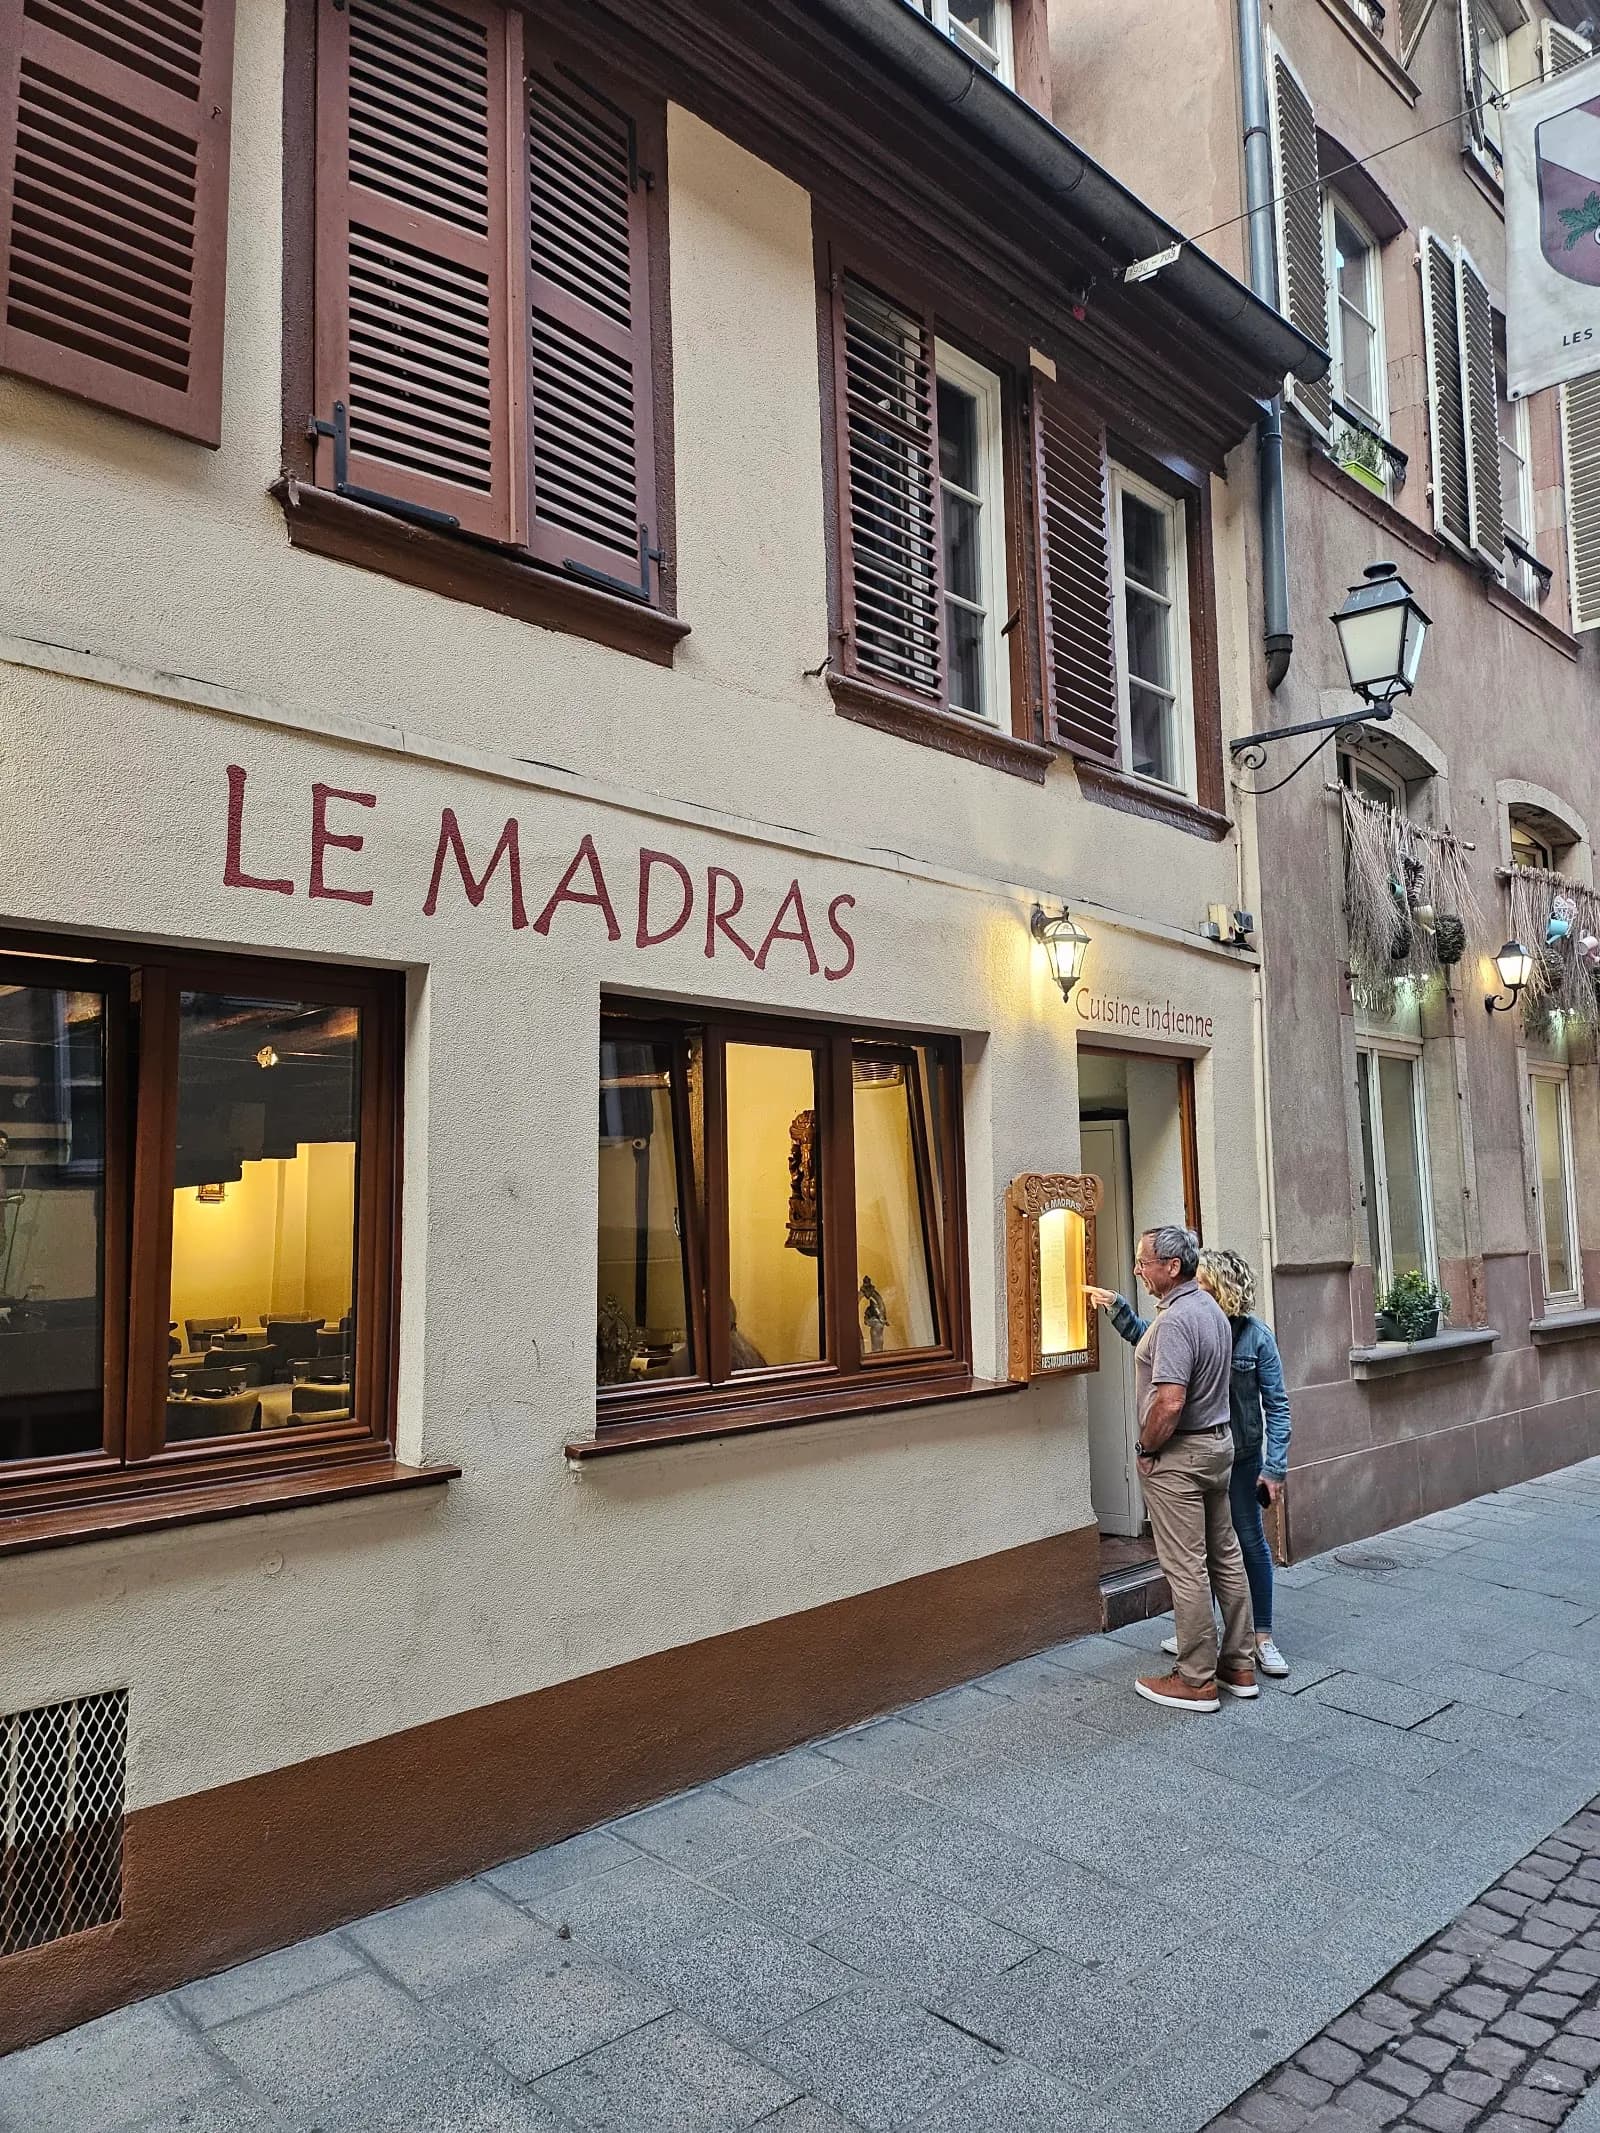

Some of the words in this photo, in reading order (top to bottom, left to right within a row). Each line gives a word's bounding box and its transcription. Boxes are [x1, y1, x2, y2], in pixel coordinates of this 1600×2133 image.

[1562, 328, 1593, 347] LES
[223, 764, 376, 905] LE
[422, 808, 856, 981] MADRAS
[1076, 988, 1140, 1026] Cuisine
[1146, 1000, 1213, 1037] indienne
[1040, 1201, 1051, 1214] LE
[1050, 1198, 1082, 1211] MADRAS
